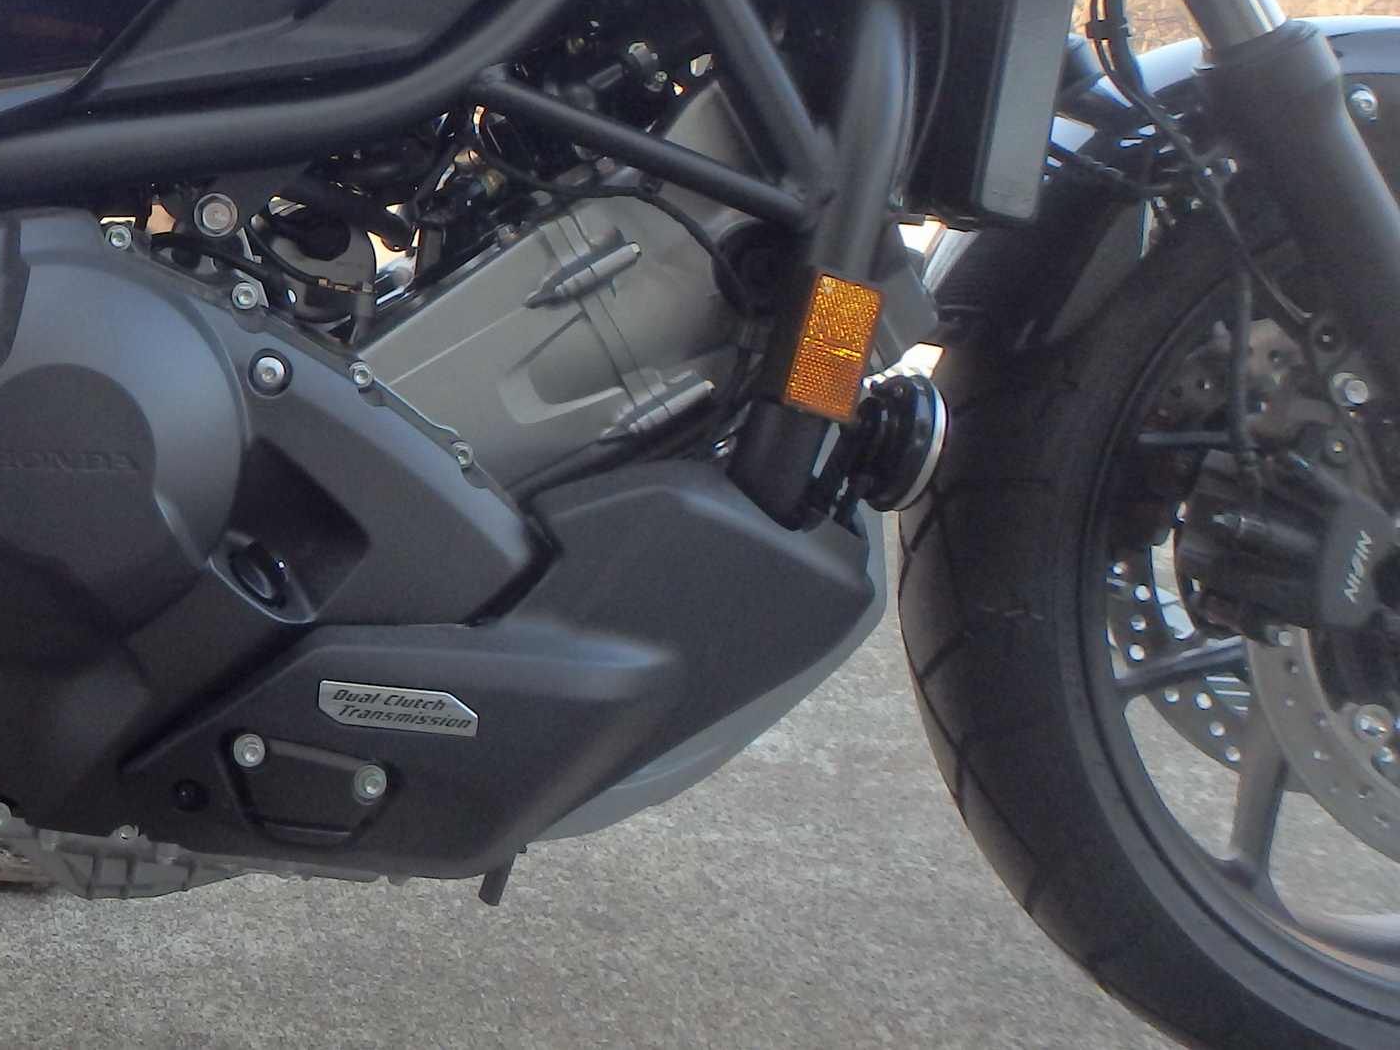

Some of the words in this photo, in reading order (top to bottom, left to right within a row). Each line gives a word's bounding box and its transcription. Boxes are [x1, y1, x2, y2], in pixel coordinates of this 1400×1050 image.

[332, 689, 381, 704] Dual
[383, 694, 446, 711] Clutch
[338, 704, 472, 729] Transmission
